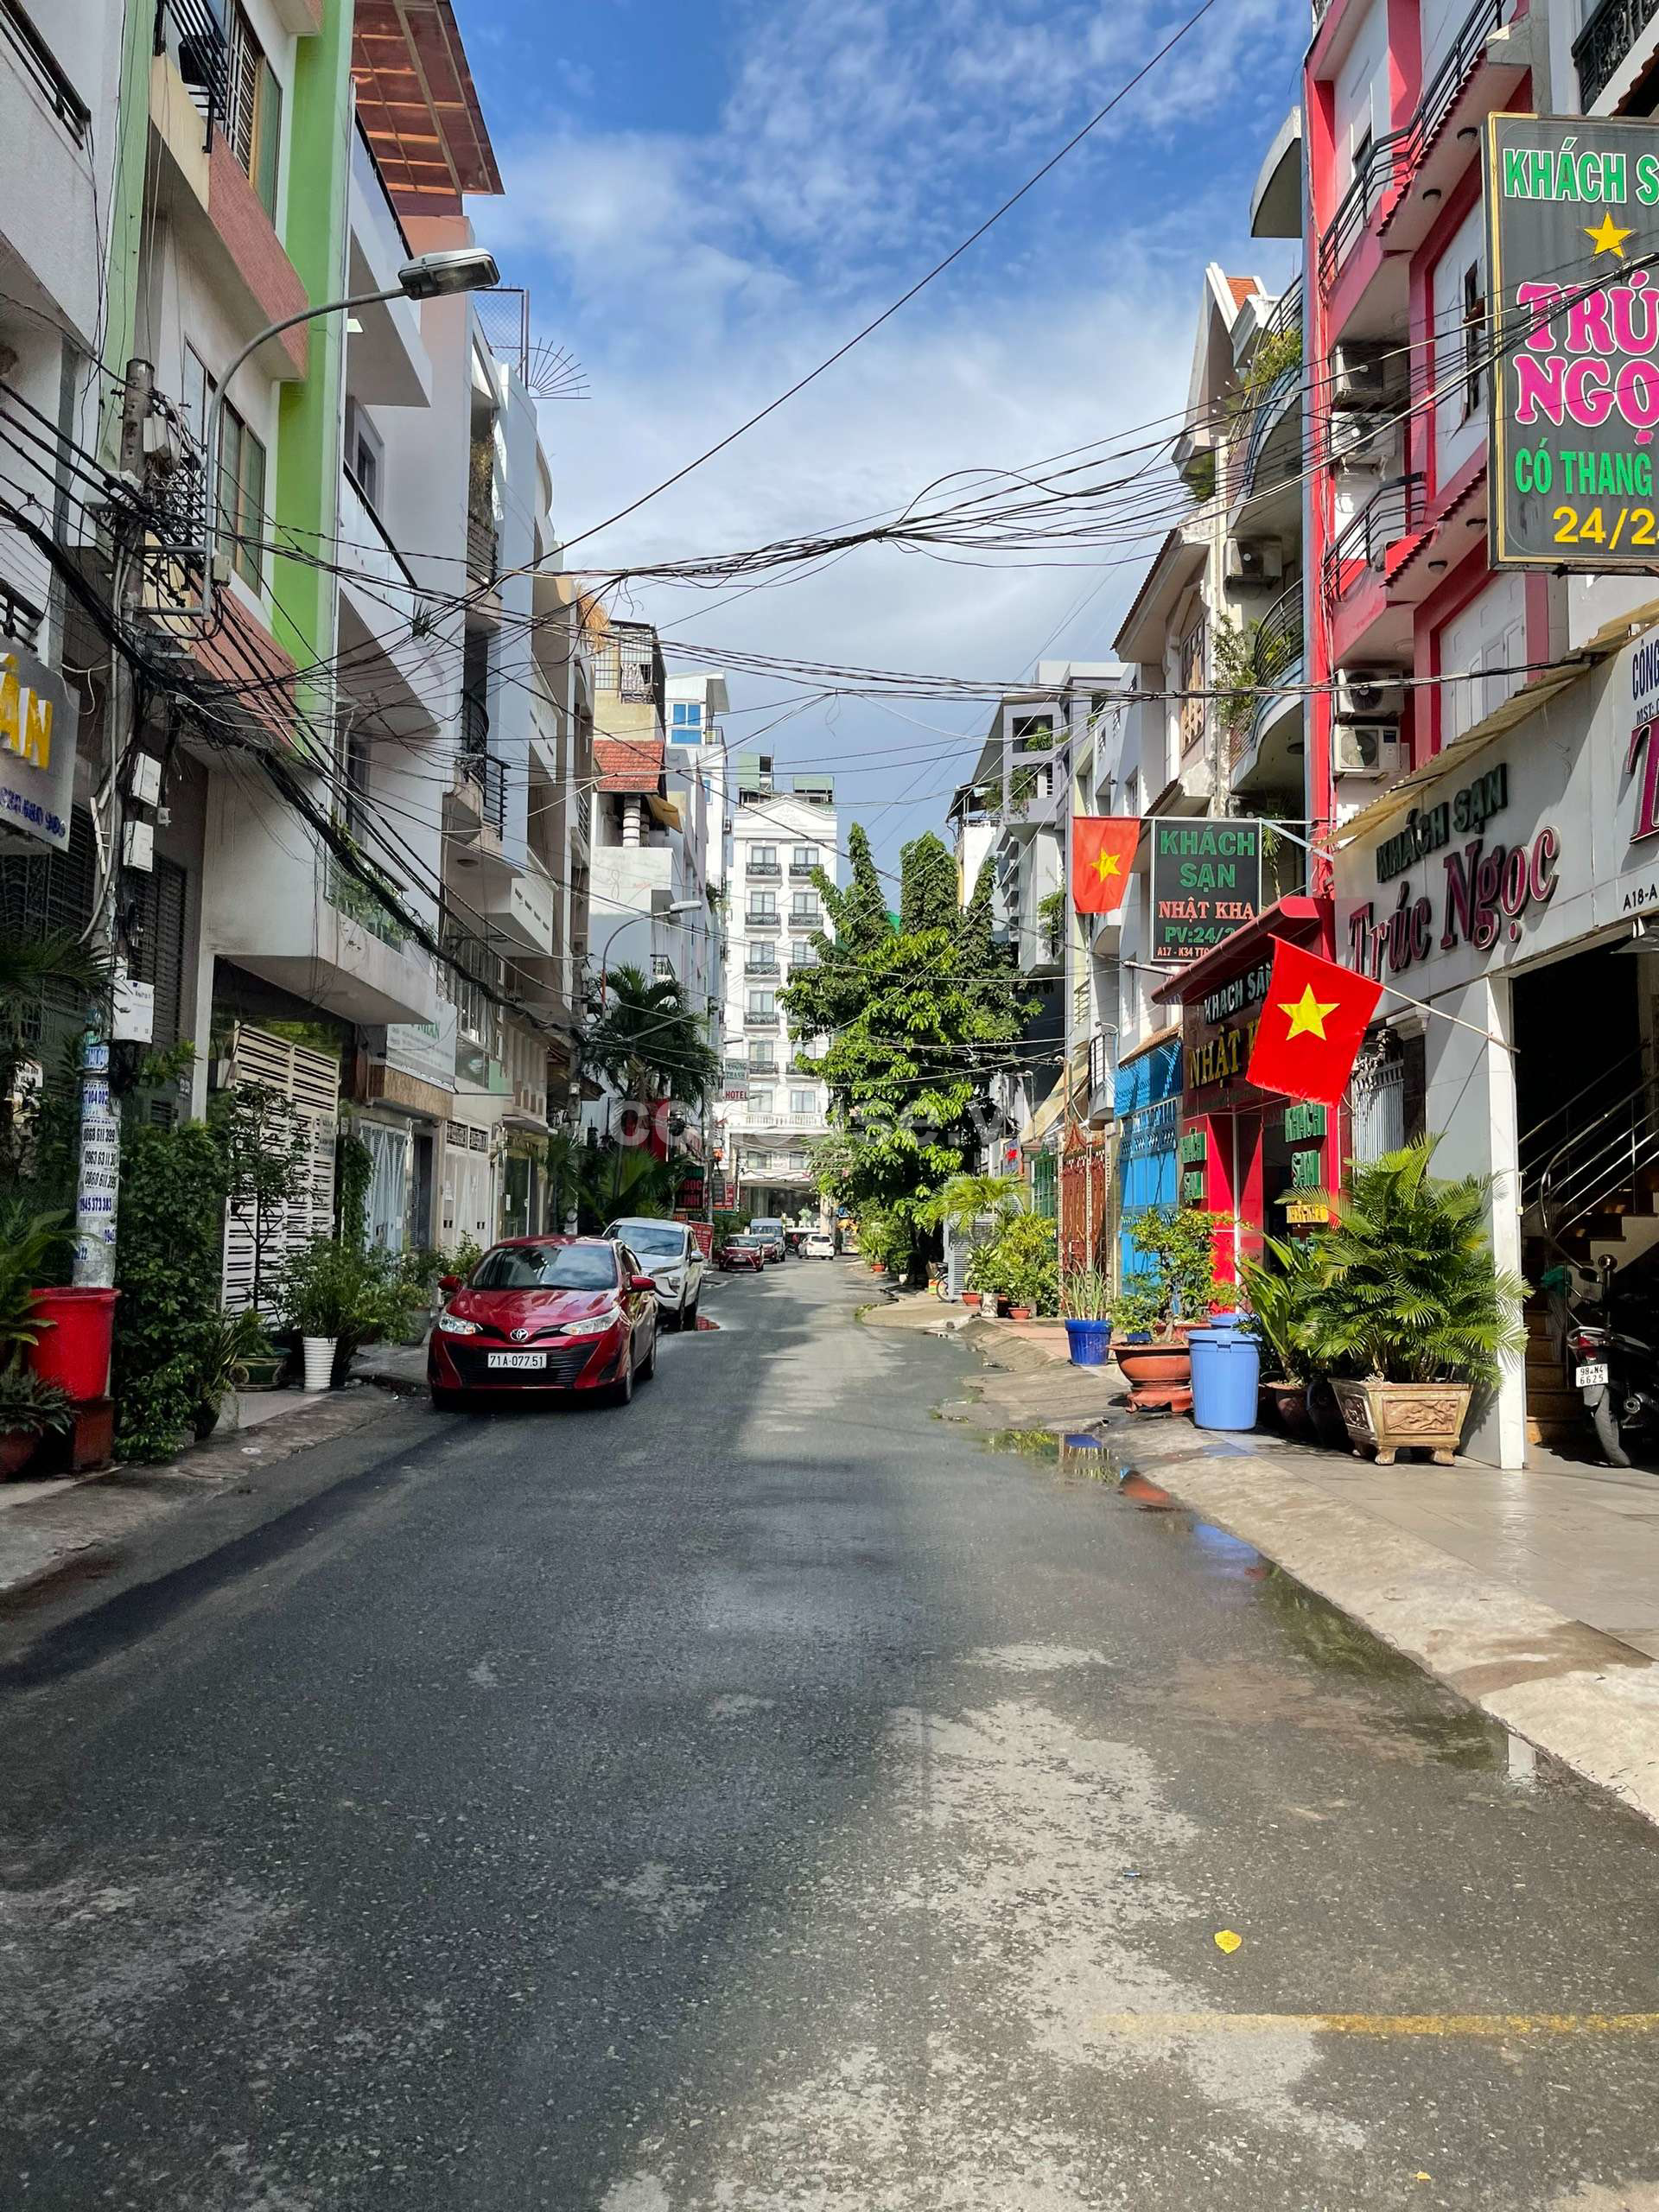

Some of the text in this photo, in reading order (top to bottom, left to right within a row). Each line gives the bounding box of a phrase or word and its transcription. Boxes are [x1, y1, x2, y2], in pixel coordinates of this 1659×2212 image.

[1503, 137, 1627, 204] KHÁCH
[1515, 436, 1653, 497] CÓ THANG
[1554, 506, 1659, 550] 24/2
[1160, 825, 1255, 855] KHÁCH
[1376, 763, 1508, 883] KHÁCH SẠN
[1180, 863, 1236, 892] SẠN
[1158, 896, 1256, 923] NHẬT KHA
[1348, 826, 1560, 982] Trúc Ngọc
[1157, 947, 1172, 957] A17
[1178, 947, 1193, 957] K34
[1189, 1024, 1241, 1089] NHẬT
[725, 1090, 747, 1100] HOTEL
